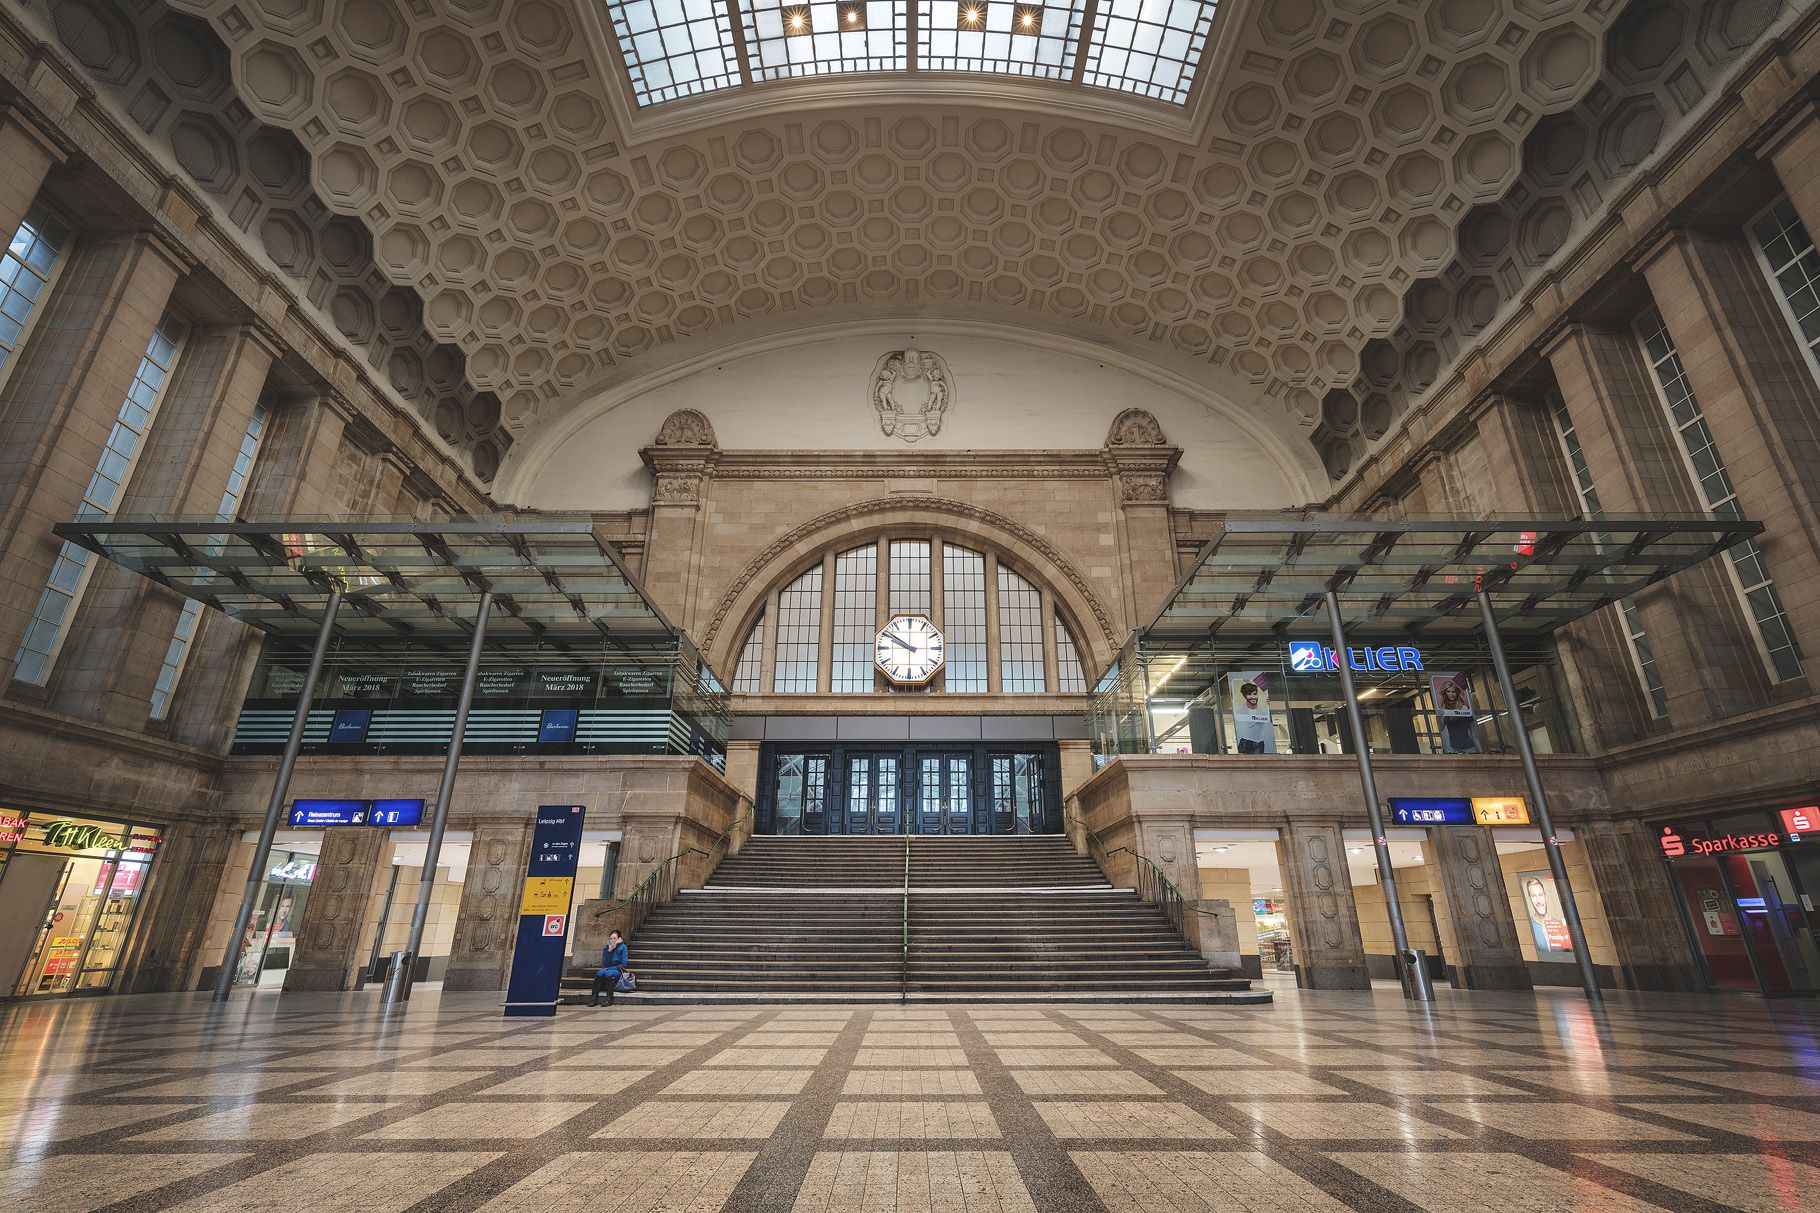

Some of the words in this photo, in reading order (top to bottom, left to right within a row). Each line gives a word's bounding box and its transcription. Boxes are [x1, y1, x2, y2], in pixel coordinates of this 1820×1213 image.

[1323, 646, 1424, 671] KLIER
[338, 674, 388, 684] Neueröffnung
[541, 674, 591, 683] Neueröffnung
[545, 683, 565, 691] März
[566, 683, 584, 691] 2018
[1691, 833, 1780, 856] Sparkasse
